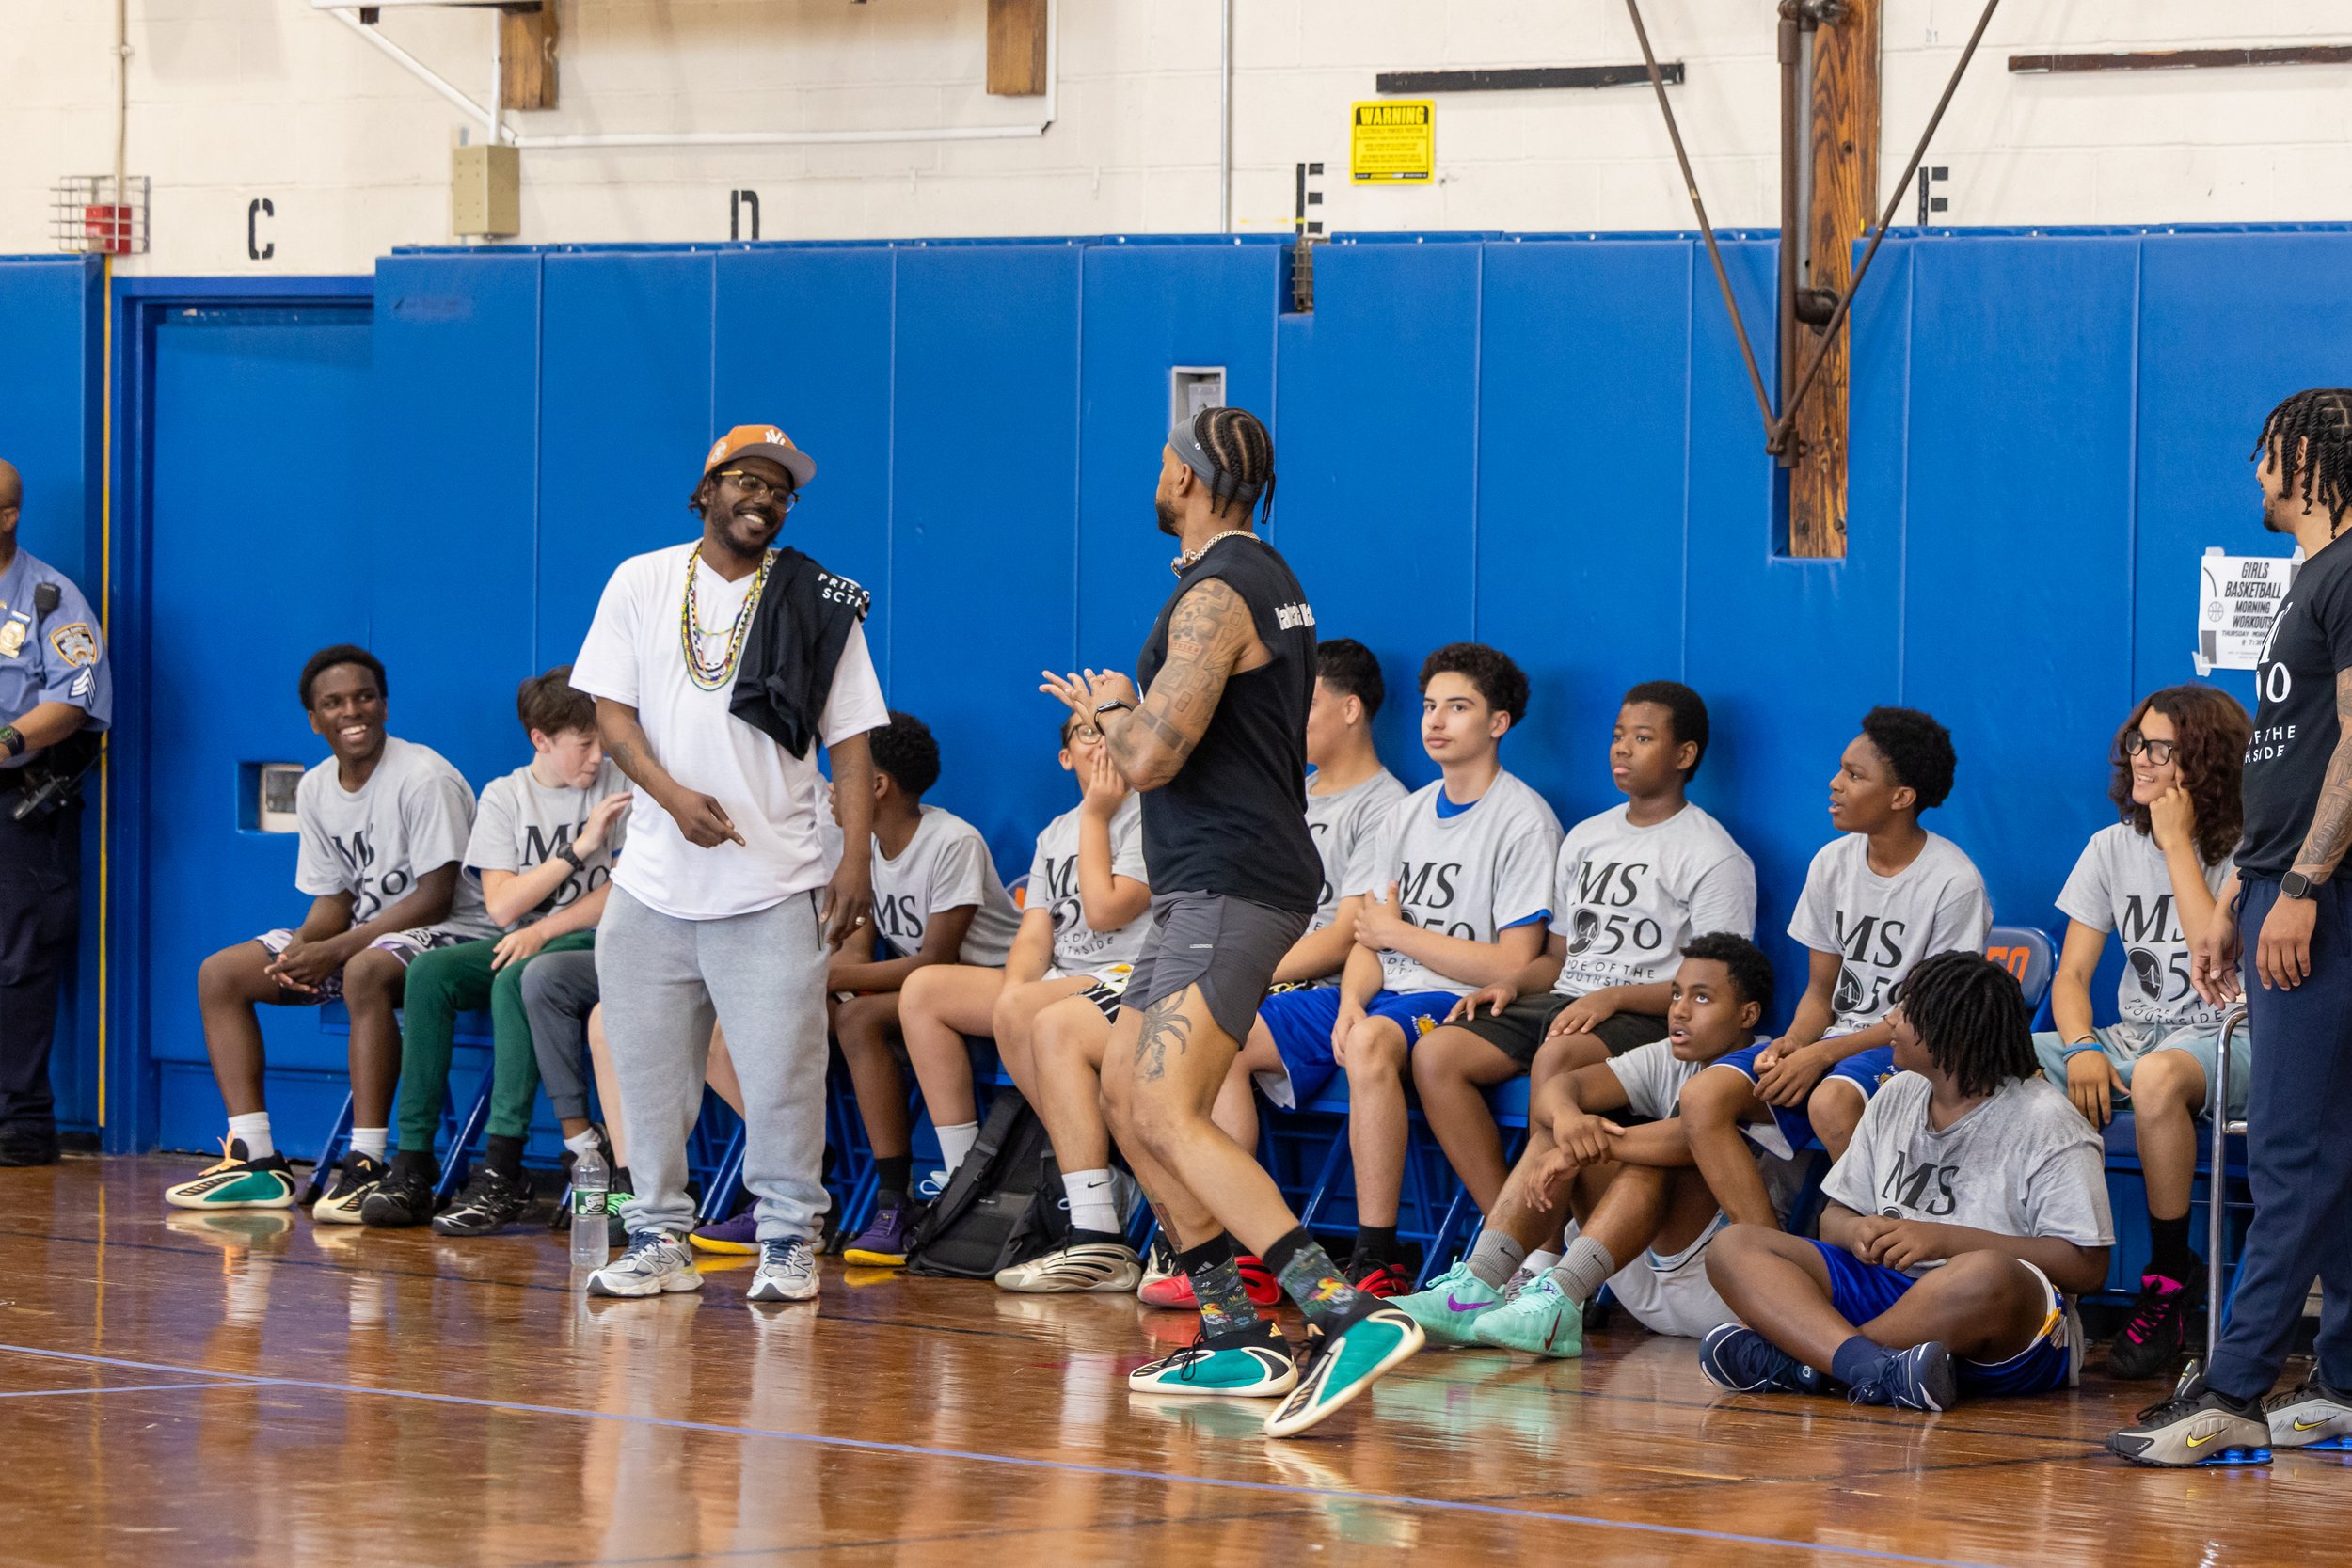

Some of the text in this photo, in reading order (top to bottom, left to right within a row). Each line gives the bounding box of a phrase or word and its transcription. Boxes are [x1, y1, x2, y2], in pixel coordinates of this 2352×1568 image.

[1359, 106, 1426, 125] WARNING
[248, 198, 274, 260] C
[2224, 581, 2282, 599] BASKETBALL
[2241, 562, 2270, 579] GIRLS
[2233, 616, 2274, 629] WORKOUTS
[2234, 601, 2271, 614] MORNING
[1396, 861, 1463, 909] MS
[1571, 861, 1649, 908] MS
[871, 894, 923, 938] MS
[1592, 914, 1662, 956] 50
[1835, 910, 1906, 969] MS
[1596, 961, 1617, 973] OF
[1623, 965, 1656, 979] THE
[1881, 1149, 1960, 1216] MS
